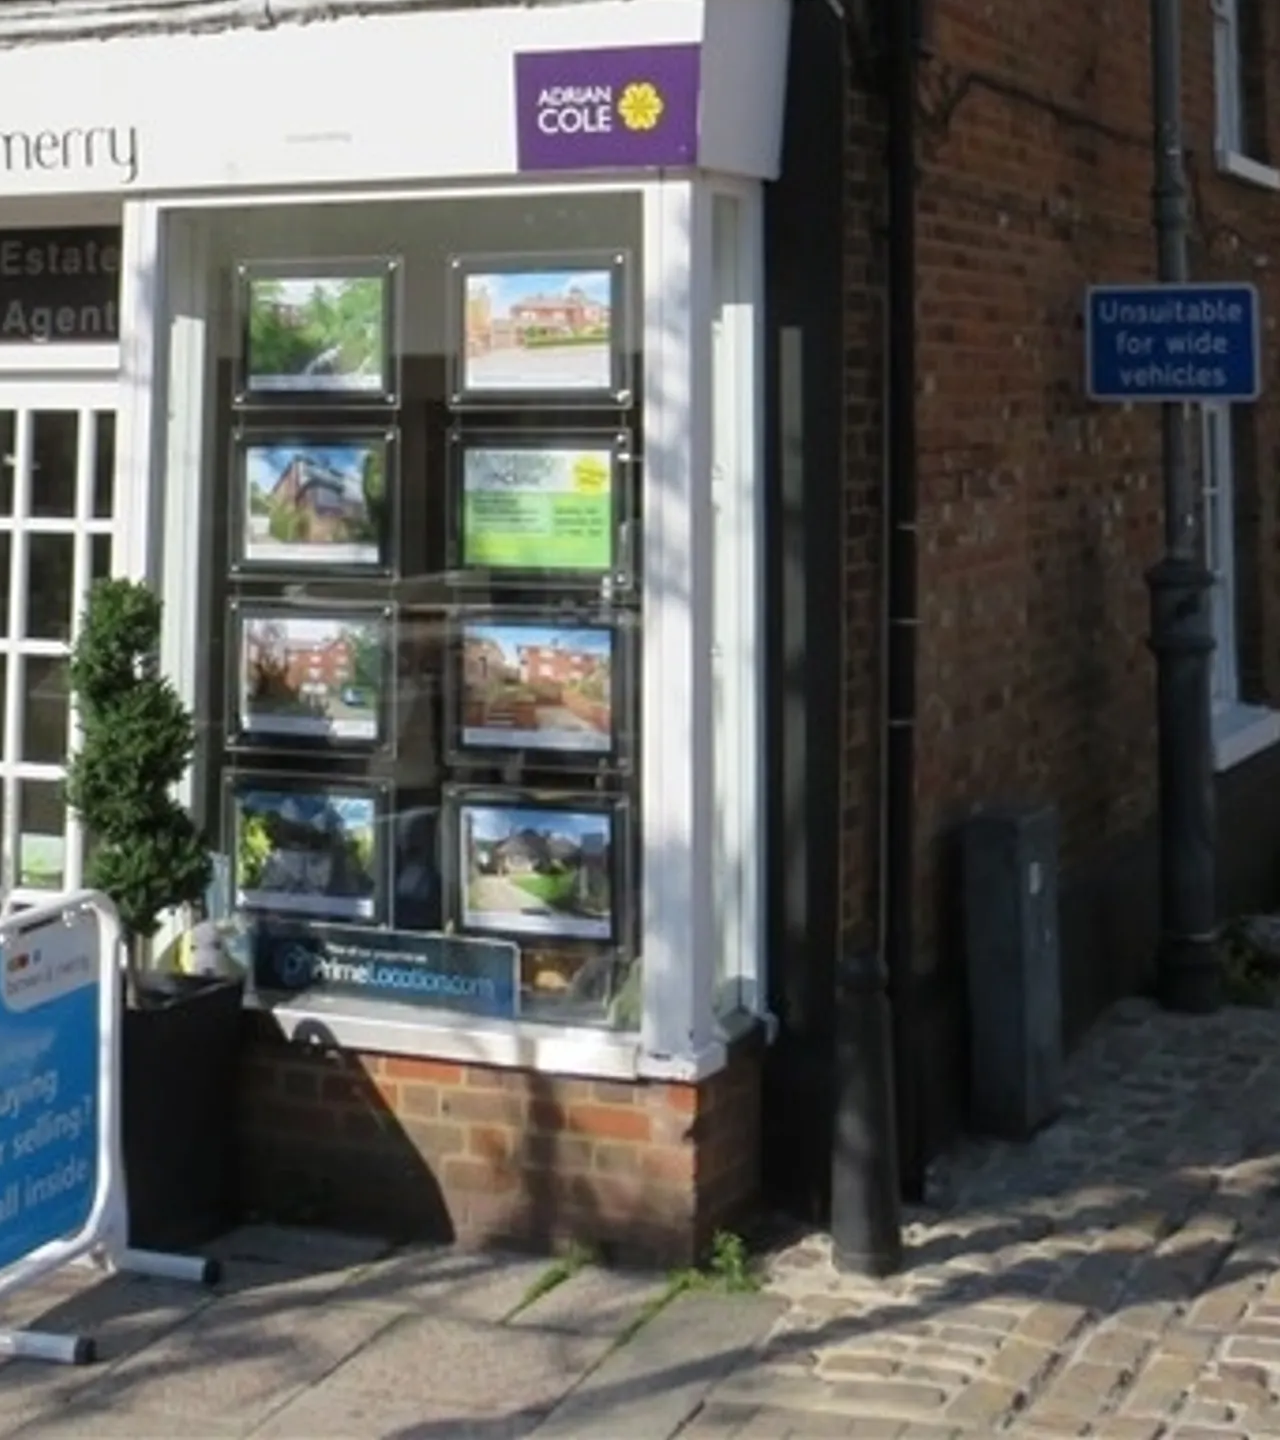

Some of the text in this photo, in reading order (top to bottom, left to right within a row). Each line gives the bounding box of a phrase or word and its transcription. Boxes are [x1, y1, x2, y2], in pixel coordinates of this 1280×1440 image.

[535, 84, 613, 107] ADRIAN
[536, 105, 613, 135] COLE
[0, 239, 120, 277] Estate
[1098, 299, 1243, 325] Unsuitable
[1116, 330, 1229, 355] for wide
[1119, 361, 1228, 388] vehicles
